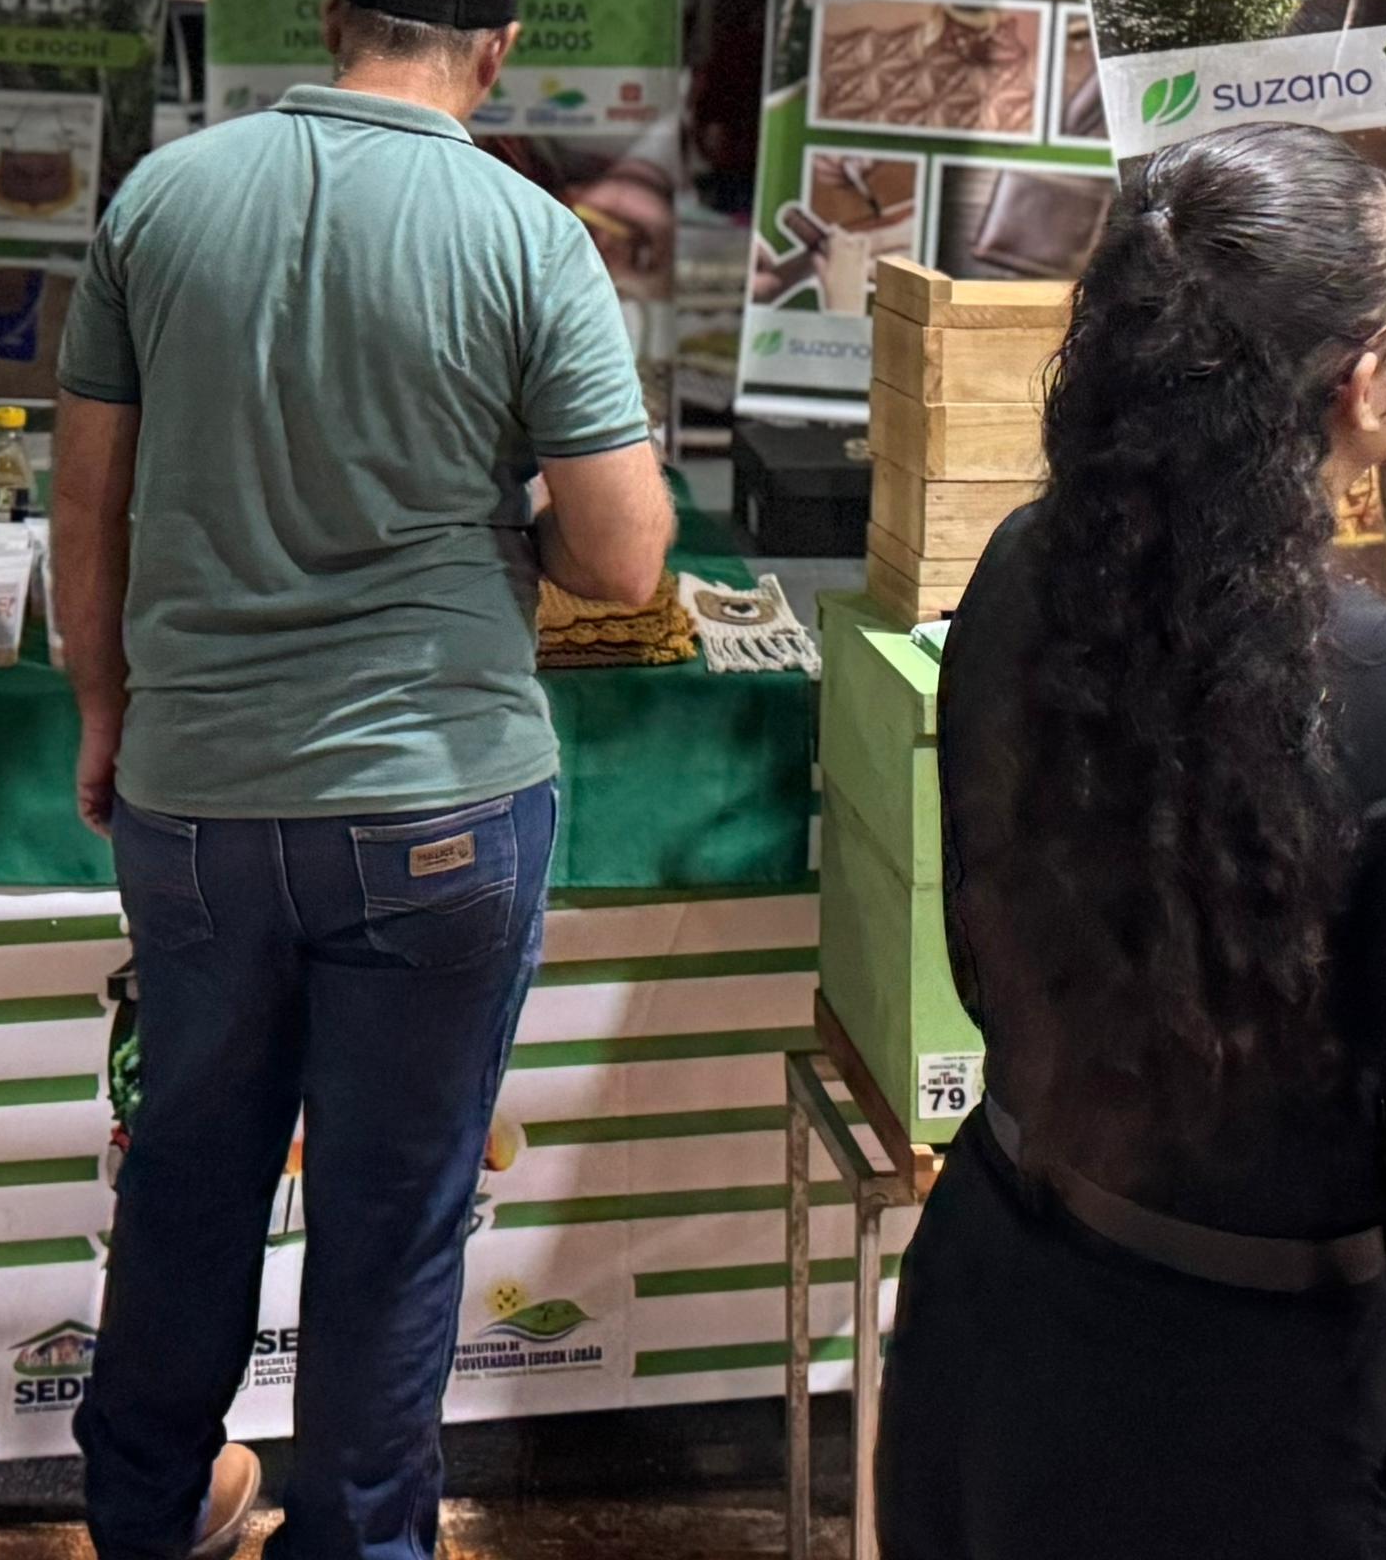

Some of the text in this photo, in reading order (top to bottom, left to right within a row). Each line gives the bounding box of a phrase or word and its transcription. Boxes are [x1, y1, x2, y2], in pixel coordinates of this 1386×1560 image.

[524, 0, 587, 23] PARA
[1213, 67, 1373, 112] suzano
[927, 1087, 966, 1111] 79
[455, 1353, 526, 1372] GOVERNADOR
[528, 1348, 567, 1366] EDISON
[14, 1376, 87, 1405] SED
